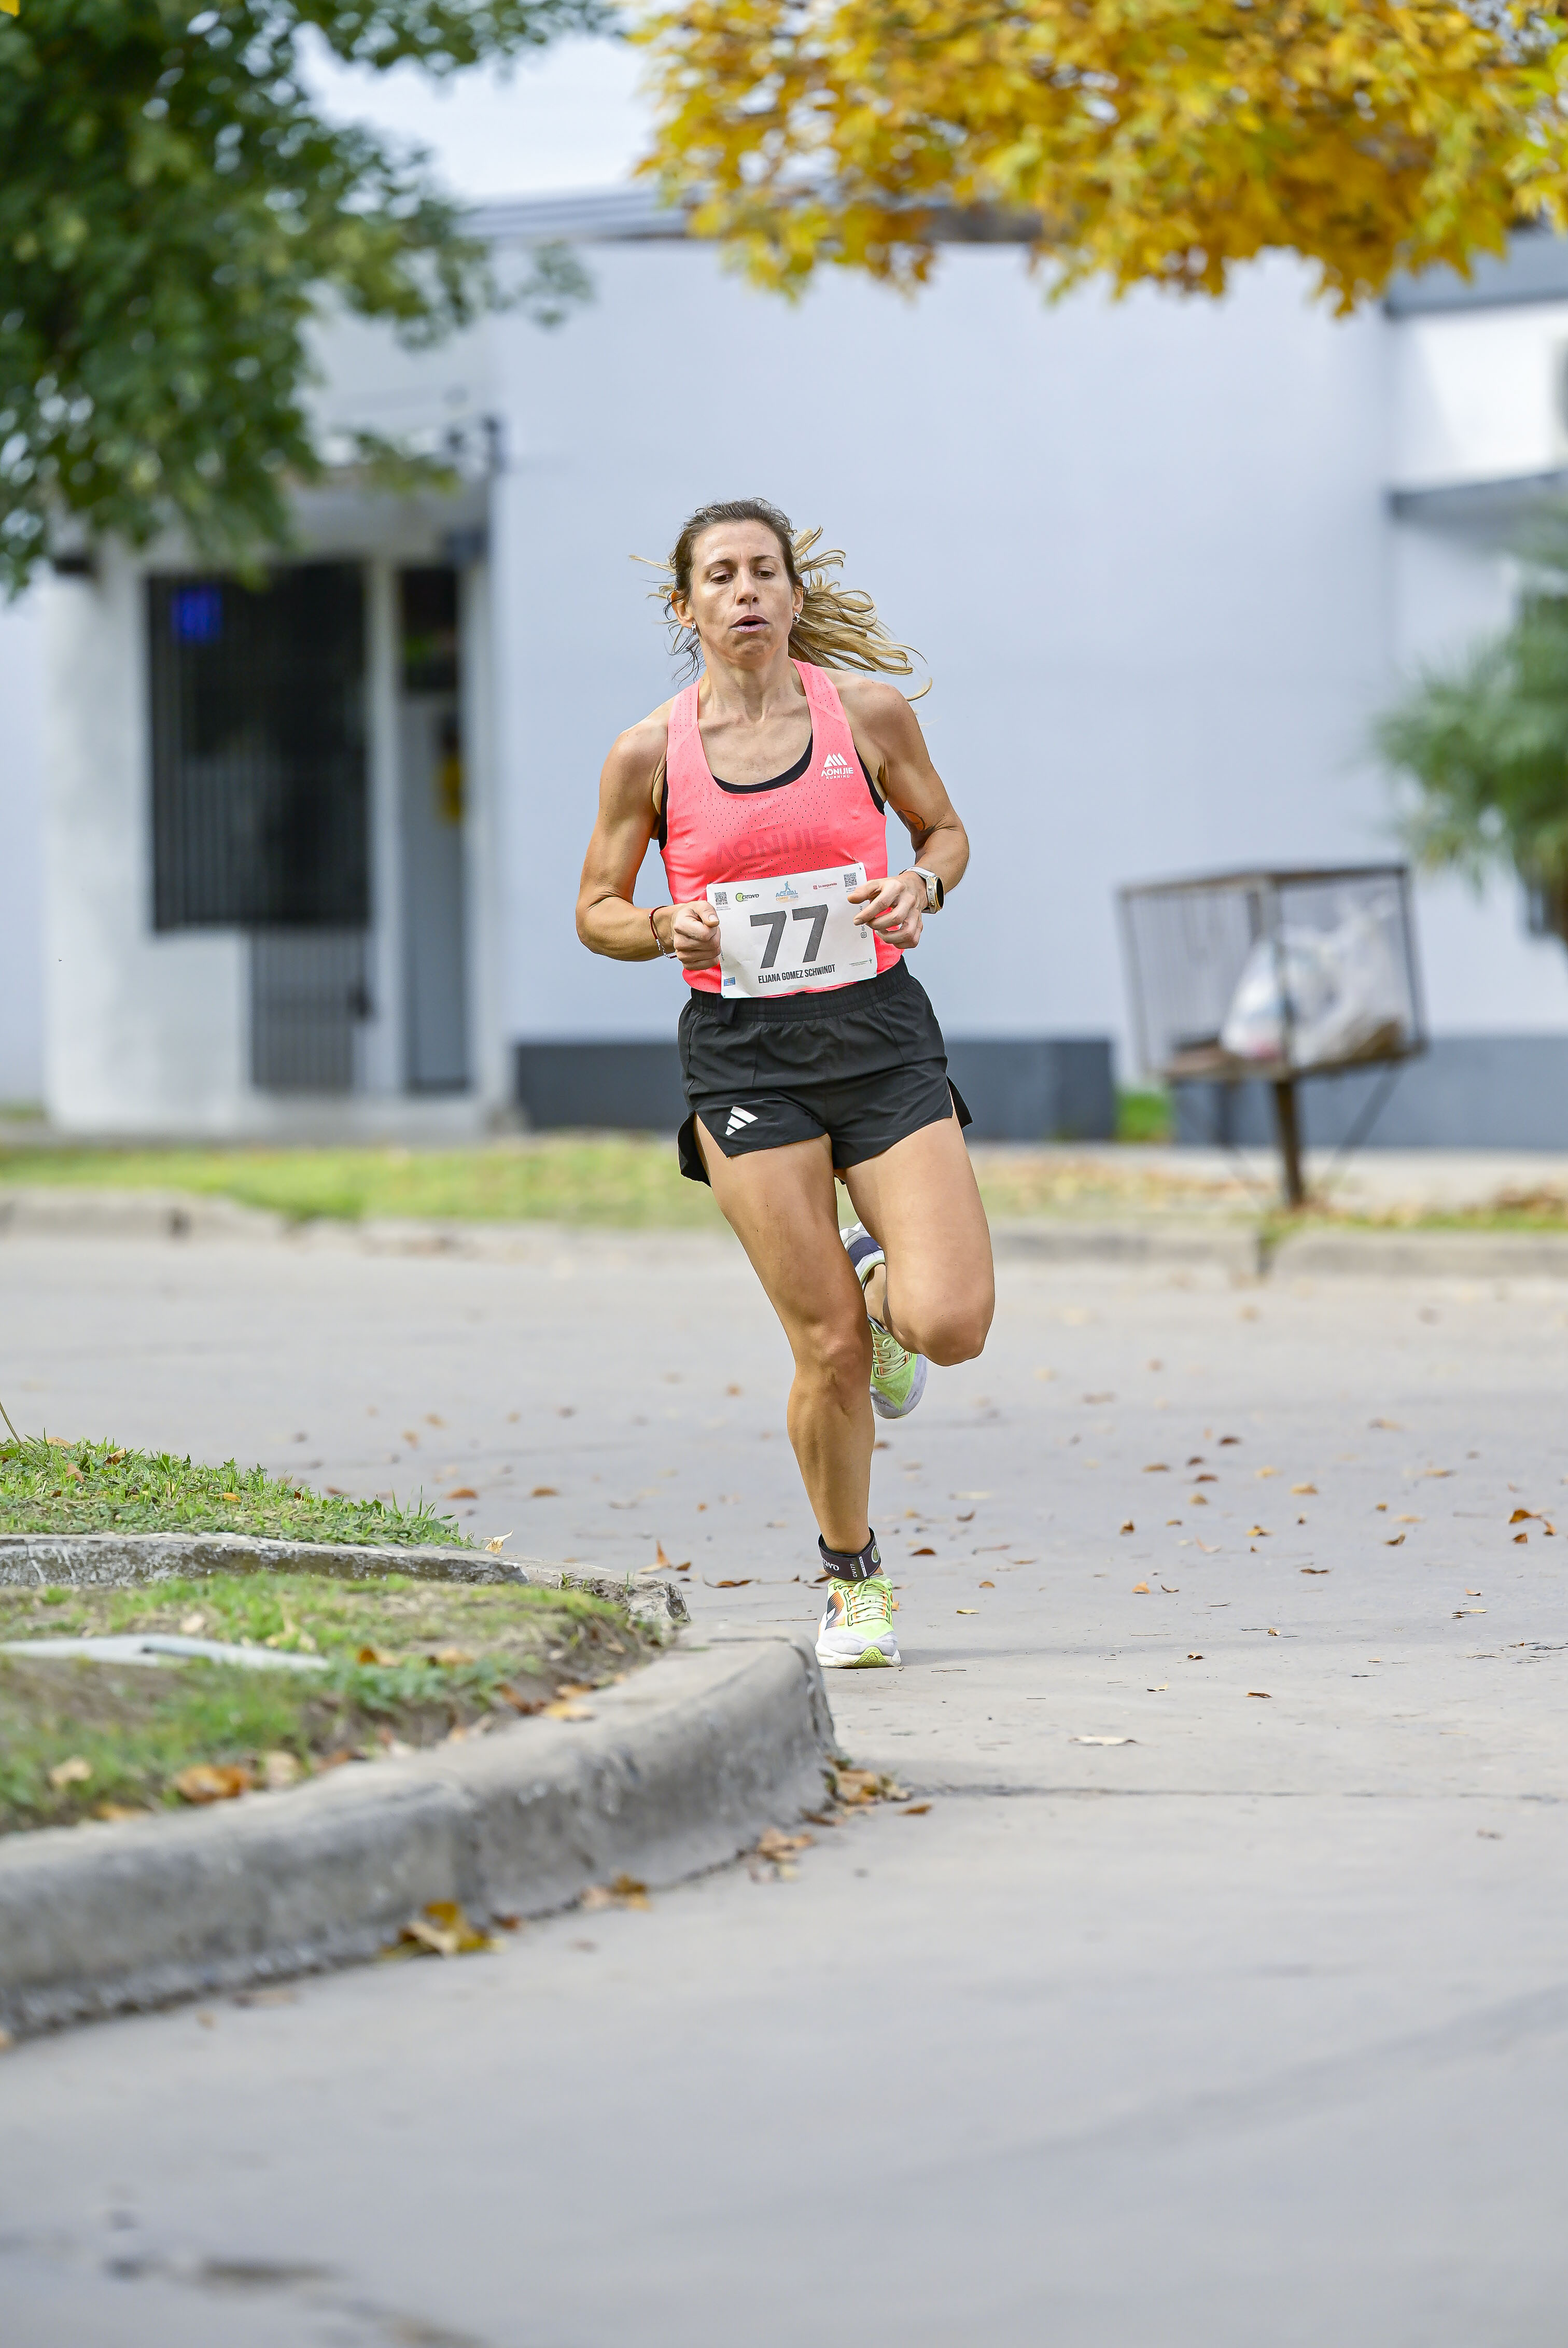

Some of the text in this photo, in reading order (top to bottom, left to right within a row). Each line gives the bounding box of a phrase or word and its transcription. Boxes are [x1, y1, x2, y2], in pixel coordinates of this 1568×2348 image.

[821, 767, 853, 777] AONIJIE
[717, 825, 832, 864] AONIJIE
[750, 904, 829, 969] 77
[758, 964, 835, 984] ELIANA GOMEZ SCHWINDT
